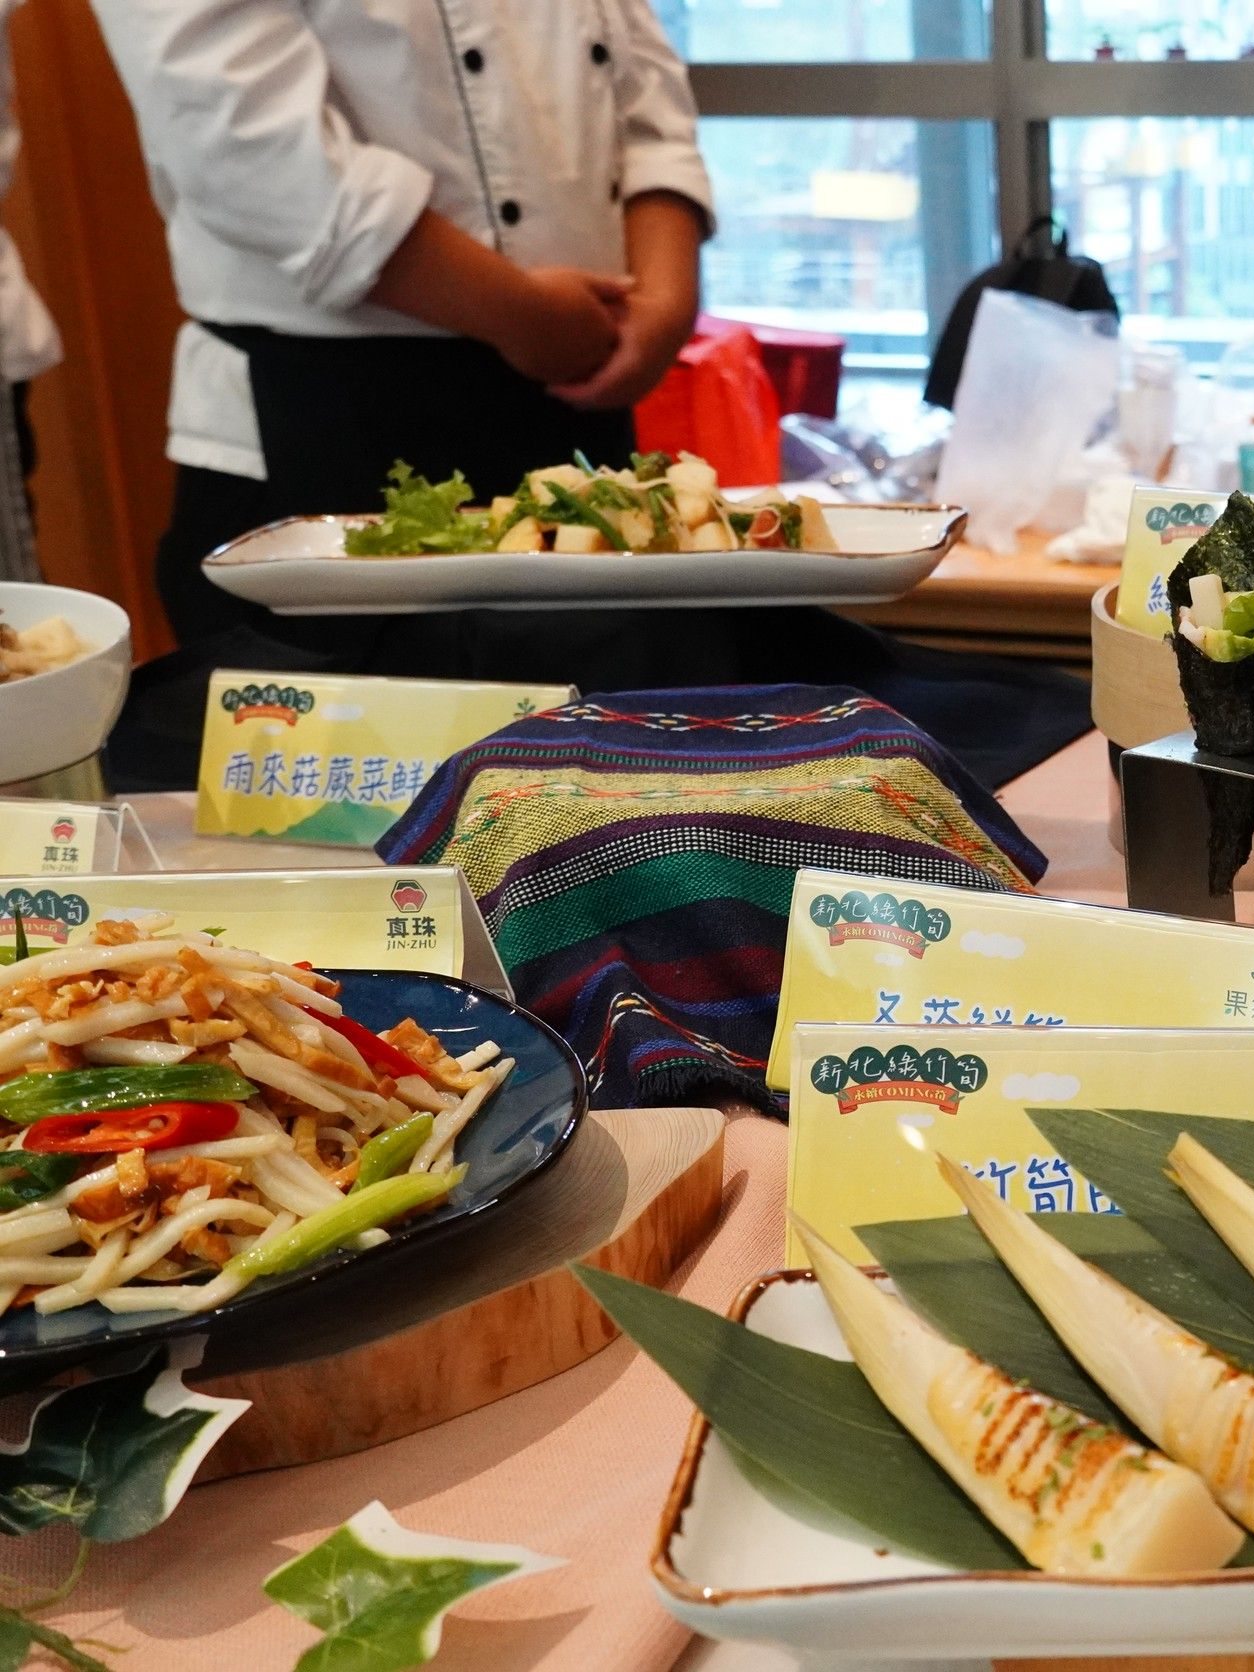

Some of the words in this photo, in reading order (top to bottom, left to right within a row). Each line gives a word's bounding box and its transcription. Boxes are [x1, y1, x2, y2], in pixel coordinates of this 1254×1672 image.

[223, 753, 441, 802] 雨來菇蕨菜鮮
[0, 893, 83, 923] 綠竹筍
[386, 917, 436, 938] 真珠
[812, 897, 944, 940] 新北綠竹筍
[814, 1051, 979, 1090] 新北綠竹筍
